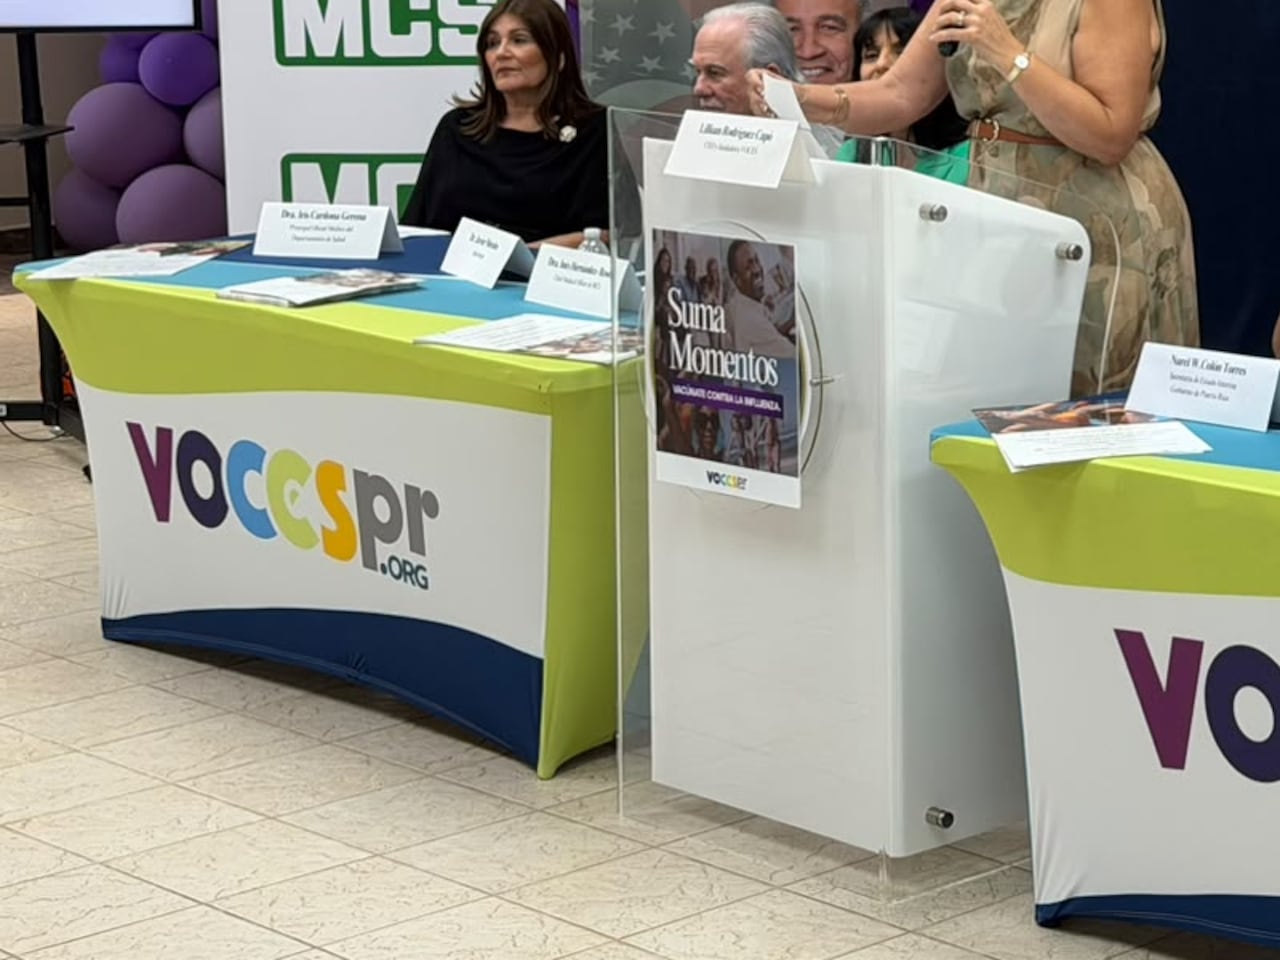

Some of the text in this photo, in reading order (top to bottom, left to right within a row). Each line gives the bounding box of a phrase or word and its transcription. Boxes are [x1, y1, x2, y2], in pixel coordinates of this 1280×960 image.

[667, 286, 726, 334] Suma
[669, 330, 779, 387] Momentos
[381, 554, 430, 590] .ORG
